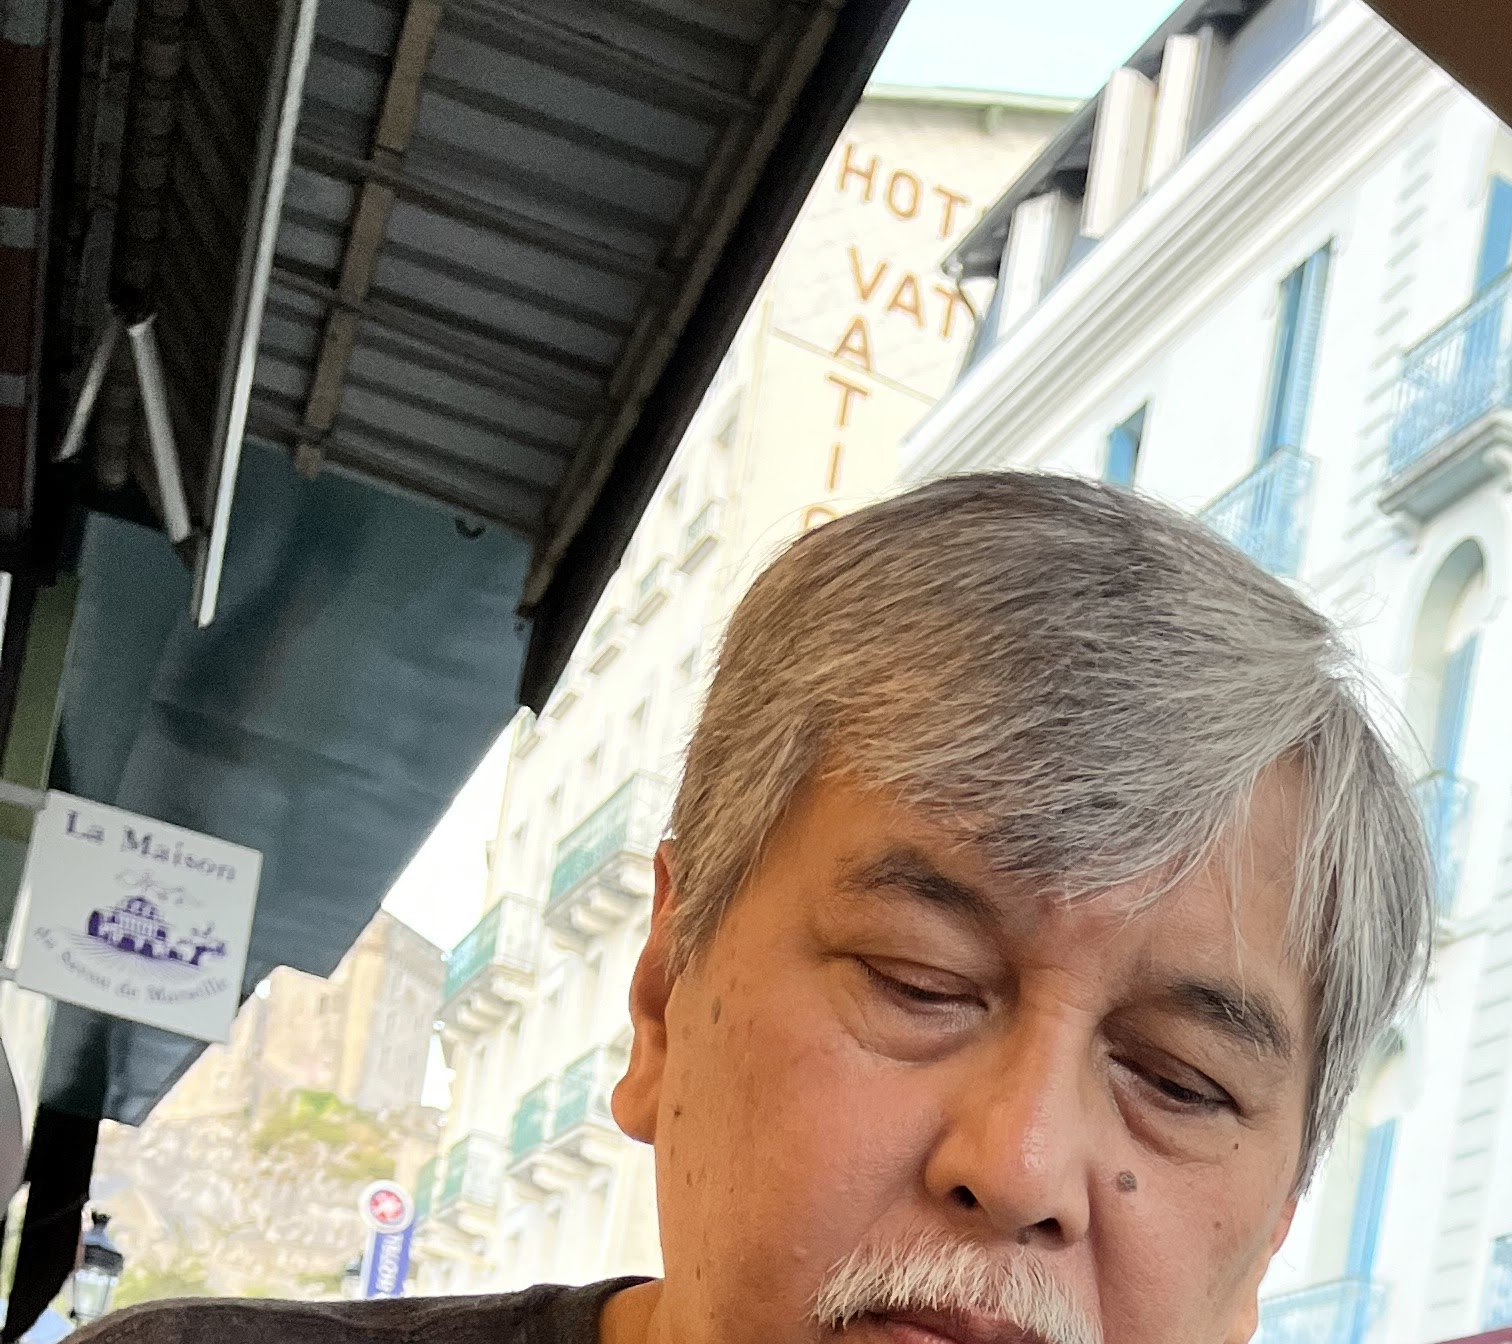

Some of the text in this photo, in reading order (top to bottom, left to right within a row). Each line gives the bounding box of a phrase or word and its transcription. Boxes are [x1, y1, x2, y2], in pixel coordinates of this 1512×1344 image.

[838, 142, 972, 240] HOT
[65, 808, 236, 881] La Maison
